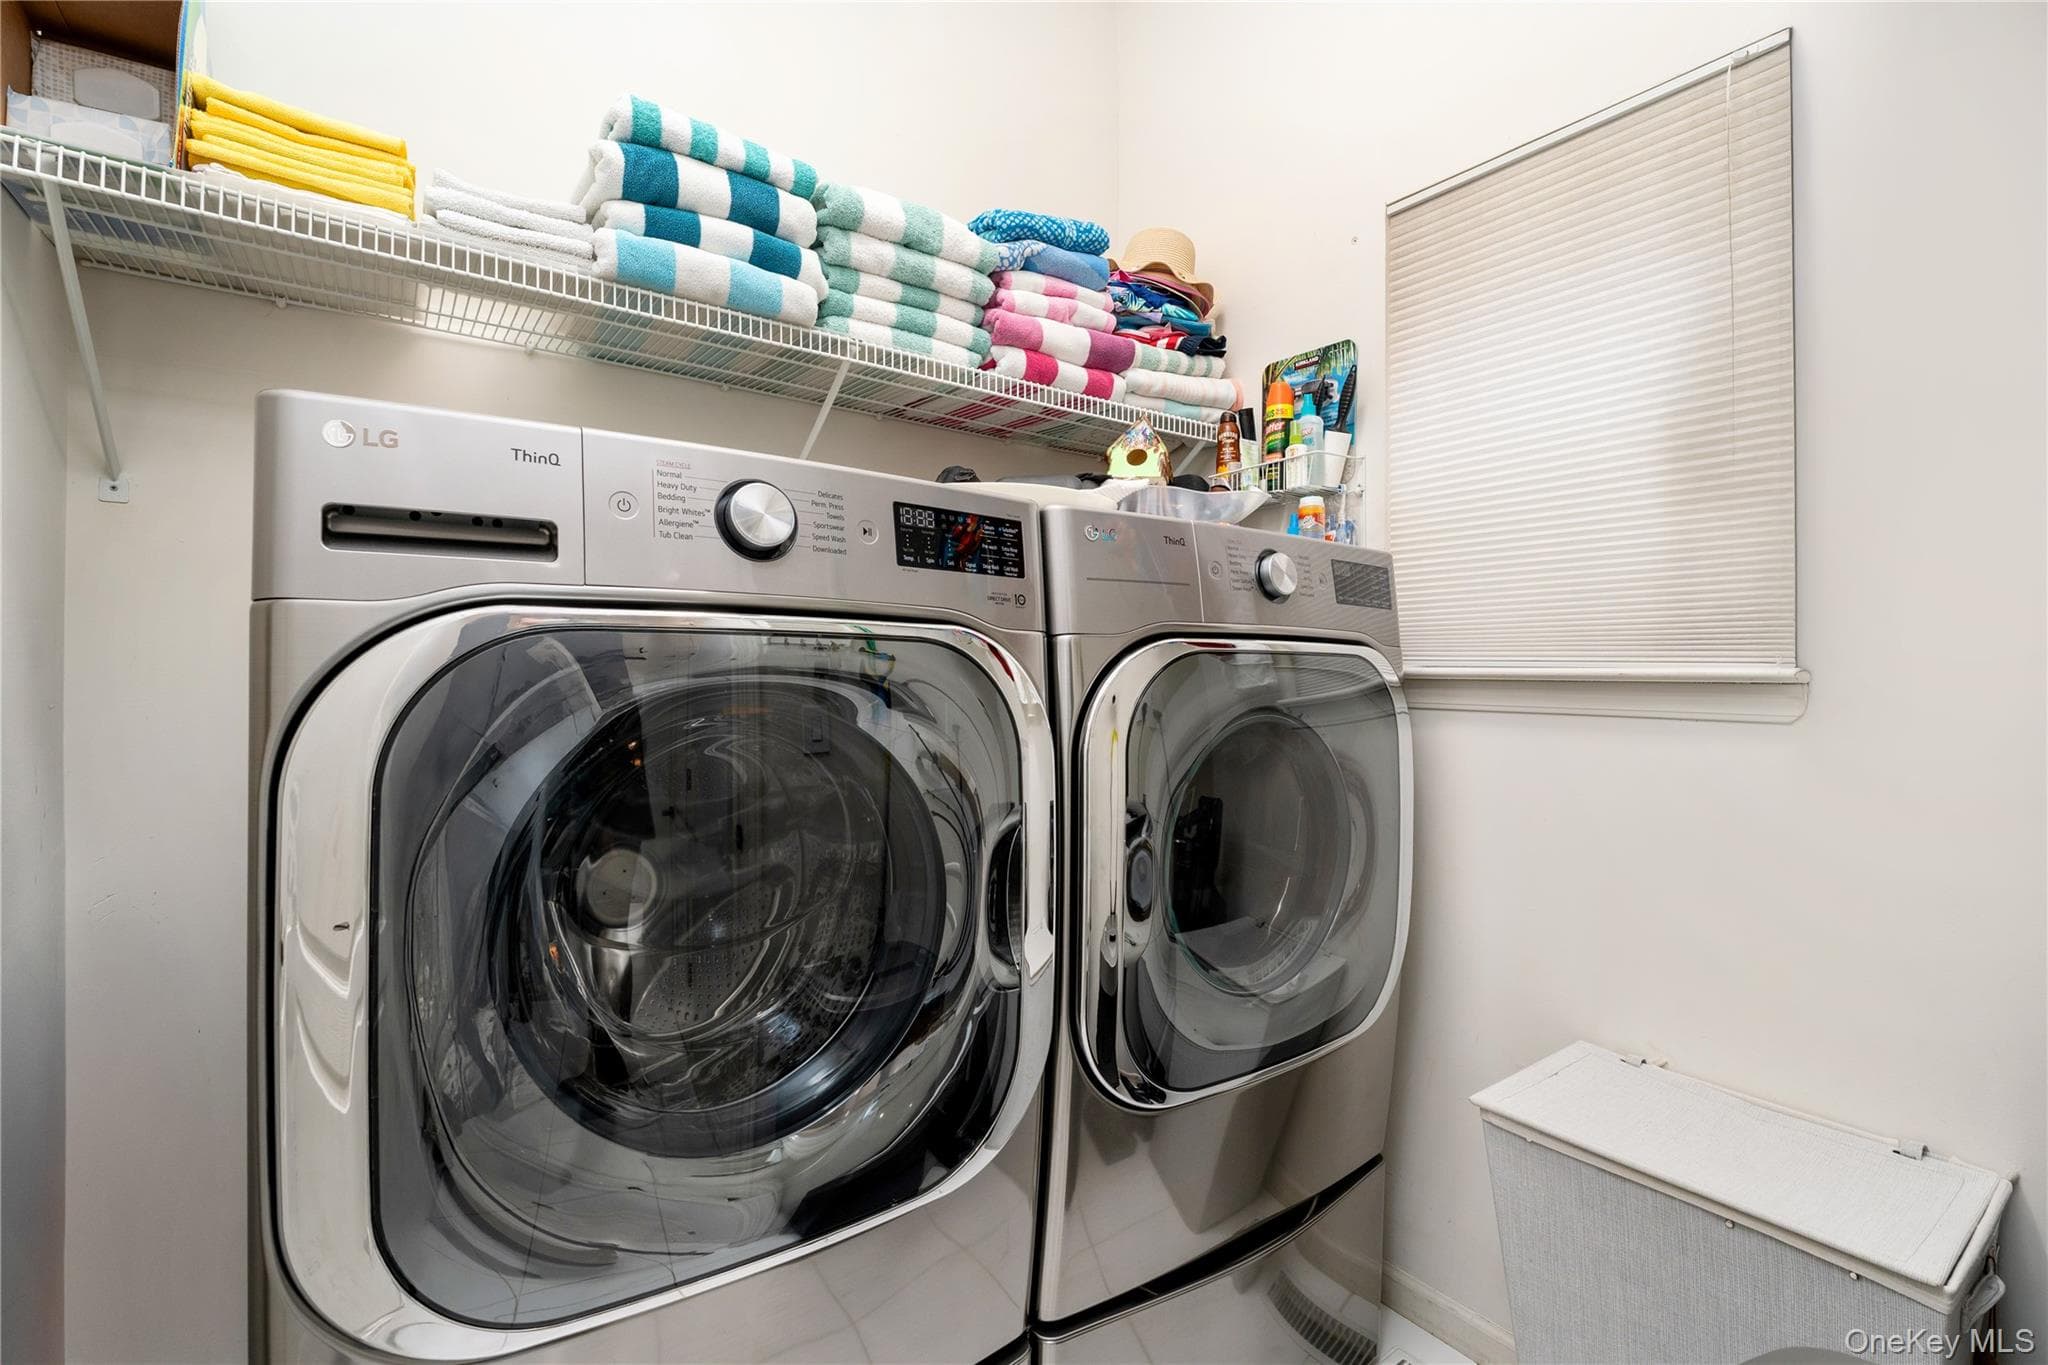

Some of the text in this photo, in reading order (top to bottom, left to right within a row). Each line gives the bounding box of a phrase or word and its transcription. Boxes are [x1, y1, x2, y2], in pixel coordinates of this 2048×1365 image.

[362, 427, 399, 449] LG
[510, 447, 561, 467] ThinQ
[656, 469, 682, 479] Normal
[657, 481, 697, 494] Heavy Duty
[657, 492, 686, 503] Bedding
[817, 490, 844, 501] Delicates
[657, 505, 680, 515] Bright
[828, 502, 845, 511] Press
[812, 521, 846, 531] Sportswear
[658, 530, 694, 541] Tub Clean
[811, 532, 847, 543] Speed Wash
[1163, 535, 1187, 547] ThinQ
[812, 544, 848, 556] Downloaded
